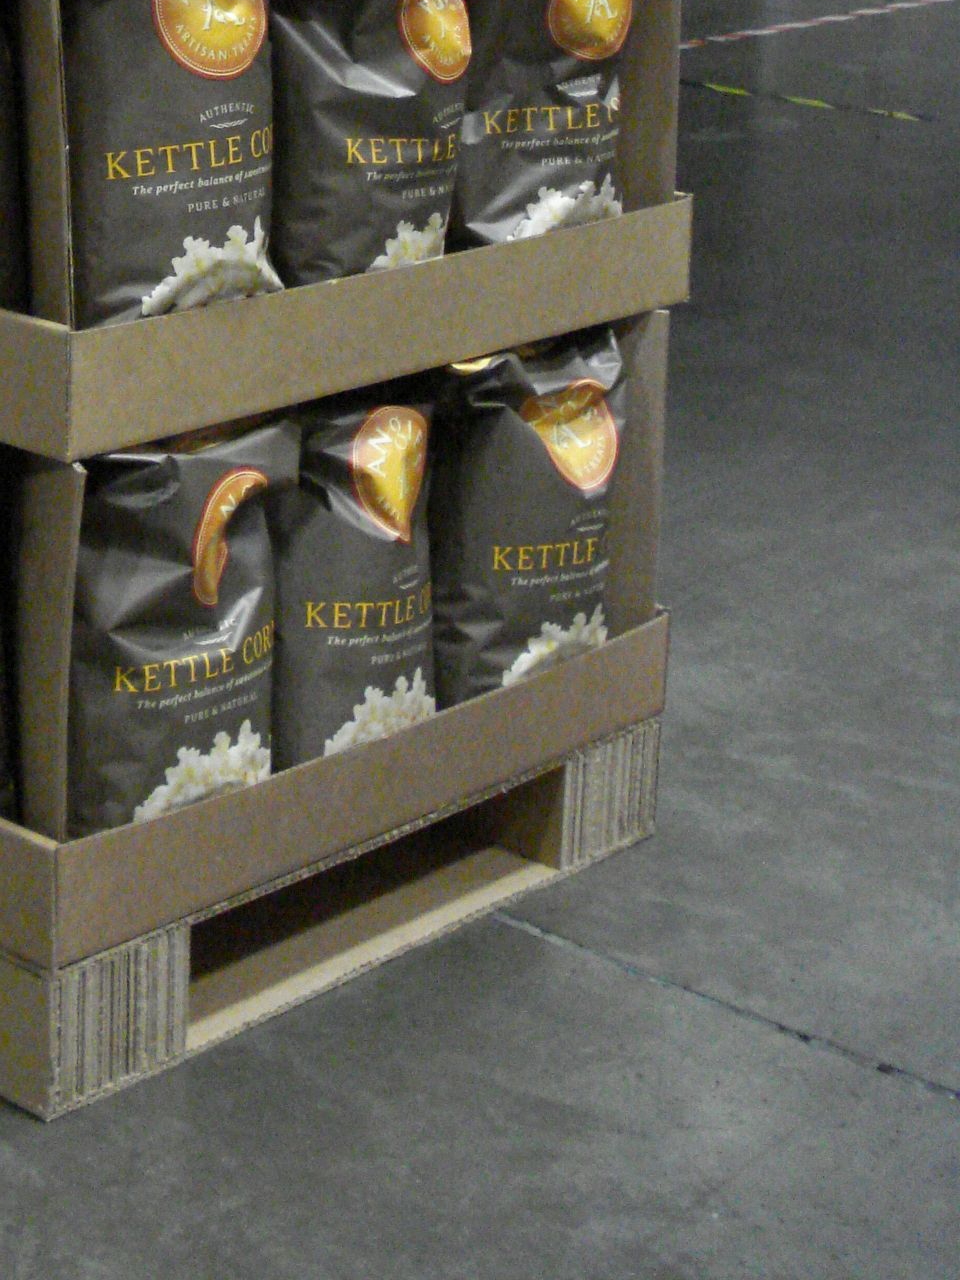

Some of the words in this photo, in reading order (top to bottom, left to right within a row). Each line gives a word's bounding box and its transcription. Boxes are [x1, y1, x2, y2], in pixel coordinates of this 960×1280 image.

[174, 23, 228, 62] ARTISAN
[199, 101, 255, 123] AUTHENTIC
[483, 102, 601, 136] KETTLE
[104, 134, 243, 180] KETTLE
[250, 123, 273, 160] CO
[345, 131, 456, 166] KETTLE
[515, 136, 550, 151] perfect
[553, 134, 589, 147] balance
[541, 156, 571, 168] PURE
[132, 185, 153, 196] The
[156, 180, 195, 195] perfect
[197, 174, 234, 190] balance
[187, 200, 219, 214] PURE
[222, 196, 231, 208] &
[493, 536, 598, 572] KETTLE
[304, 594, 417, 629] KETTLE
[113, 647, 234, 694] KETTLE
[242, 620, 275, 667] COR
